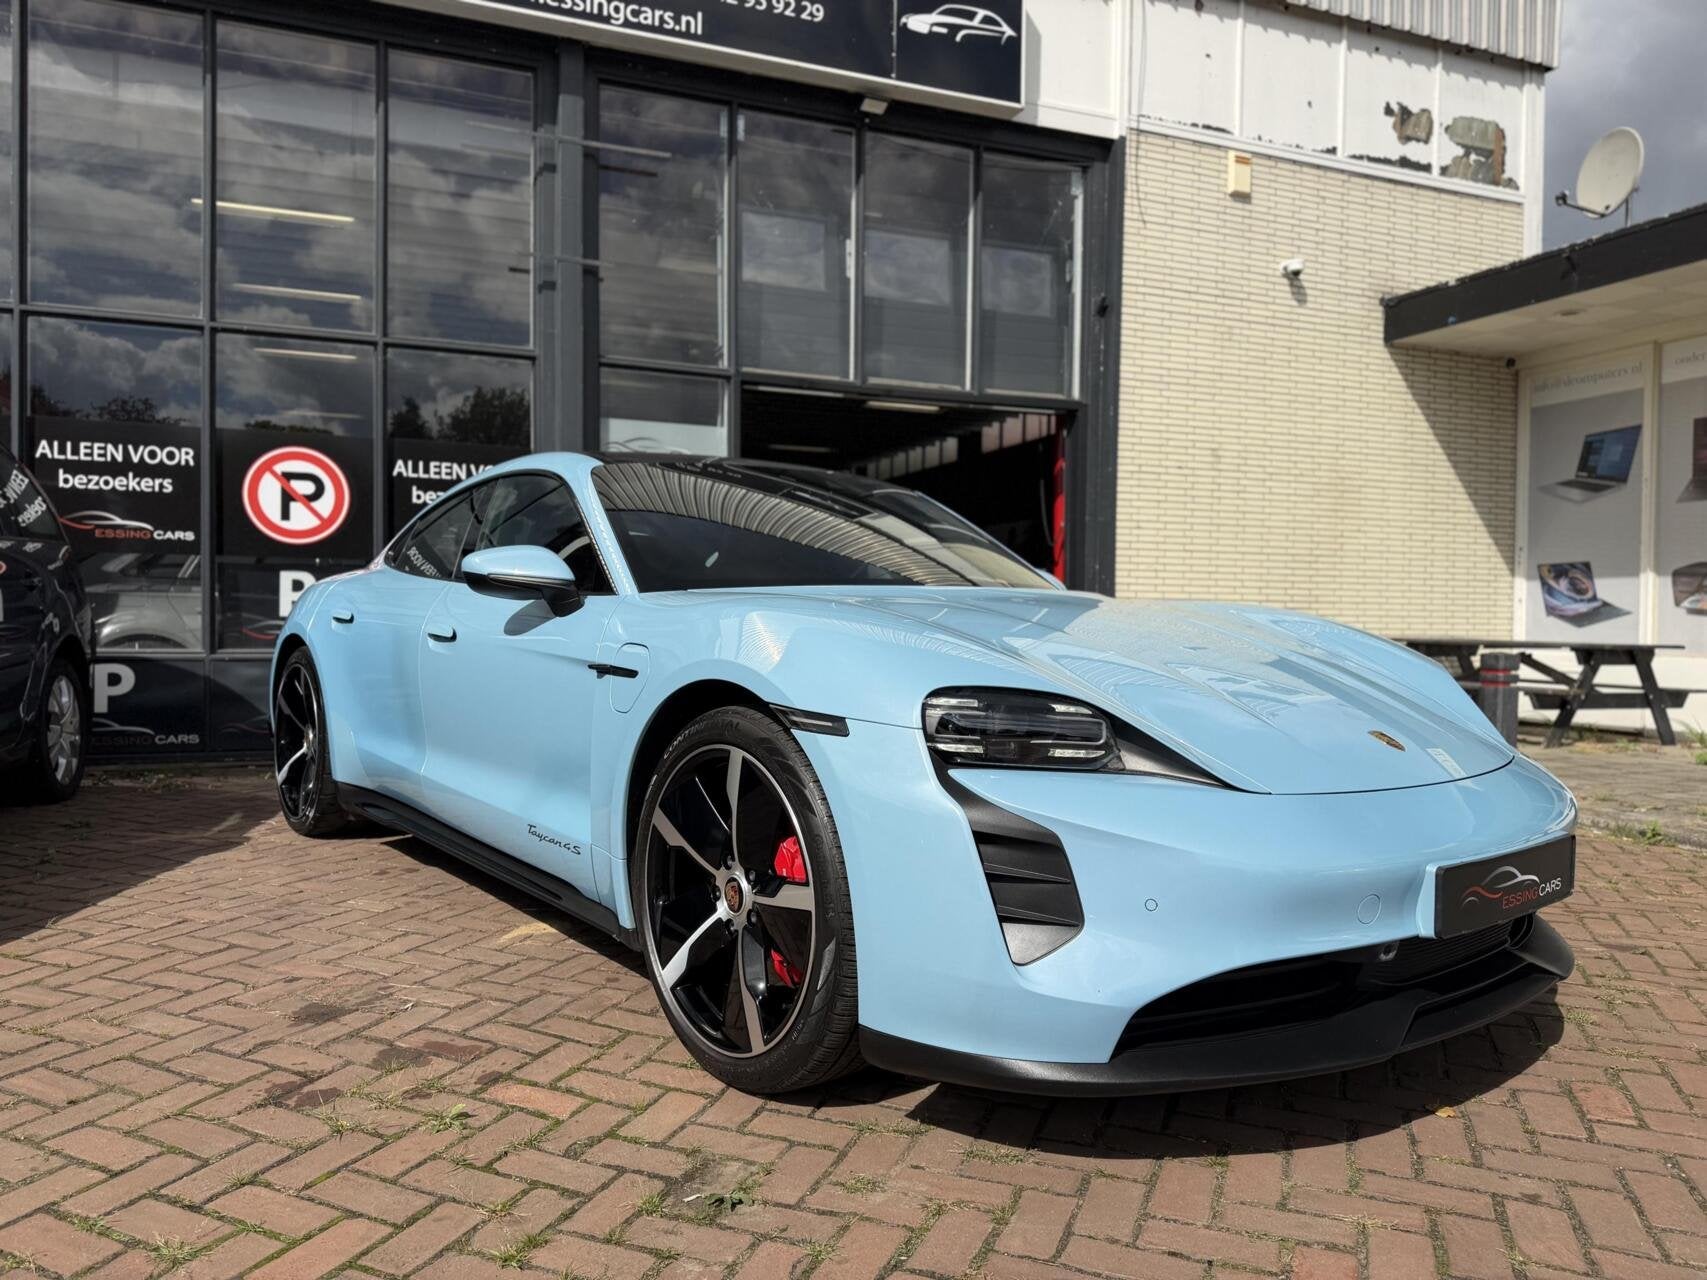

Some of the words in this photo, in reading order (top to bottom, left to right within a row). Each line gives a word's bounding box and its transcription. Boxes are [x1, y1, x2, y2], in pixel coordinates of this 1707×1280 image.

[771, 0, 796, 17] 92
[800, 1, 825, 23] 29
[35, 439, 124, 463] ALLEEN
[128, 442, 195, 467] VOOR
[58, 469, 173, 493] bezoekers
[392, 458, 467, 481] ALLEEN
[93, 663, 135, 713] P
[527, 824, 562, 847] Taycan
